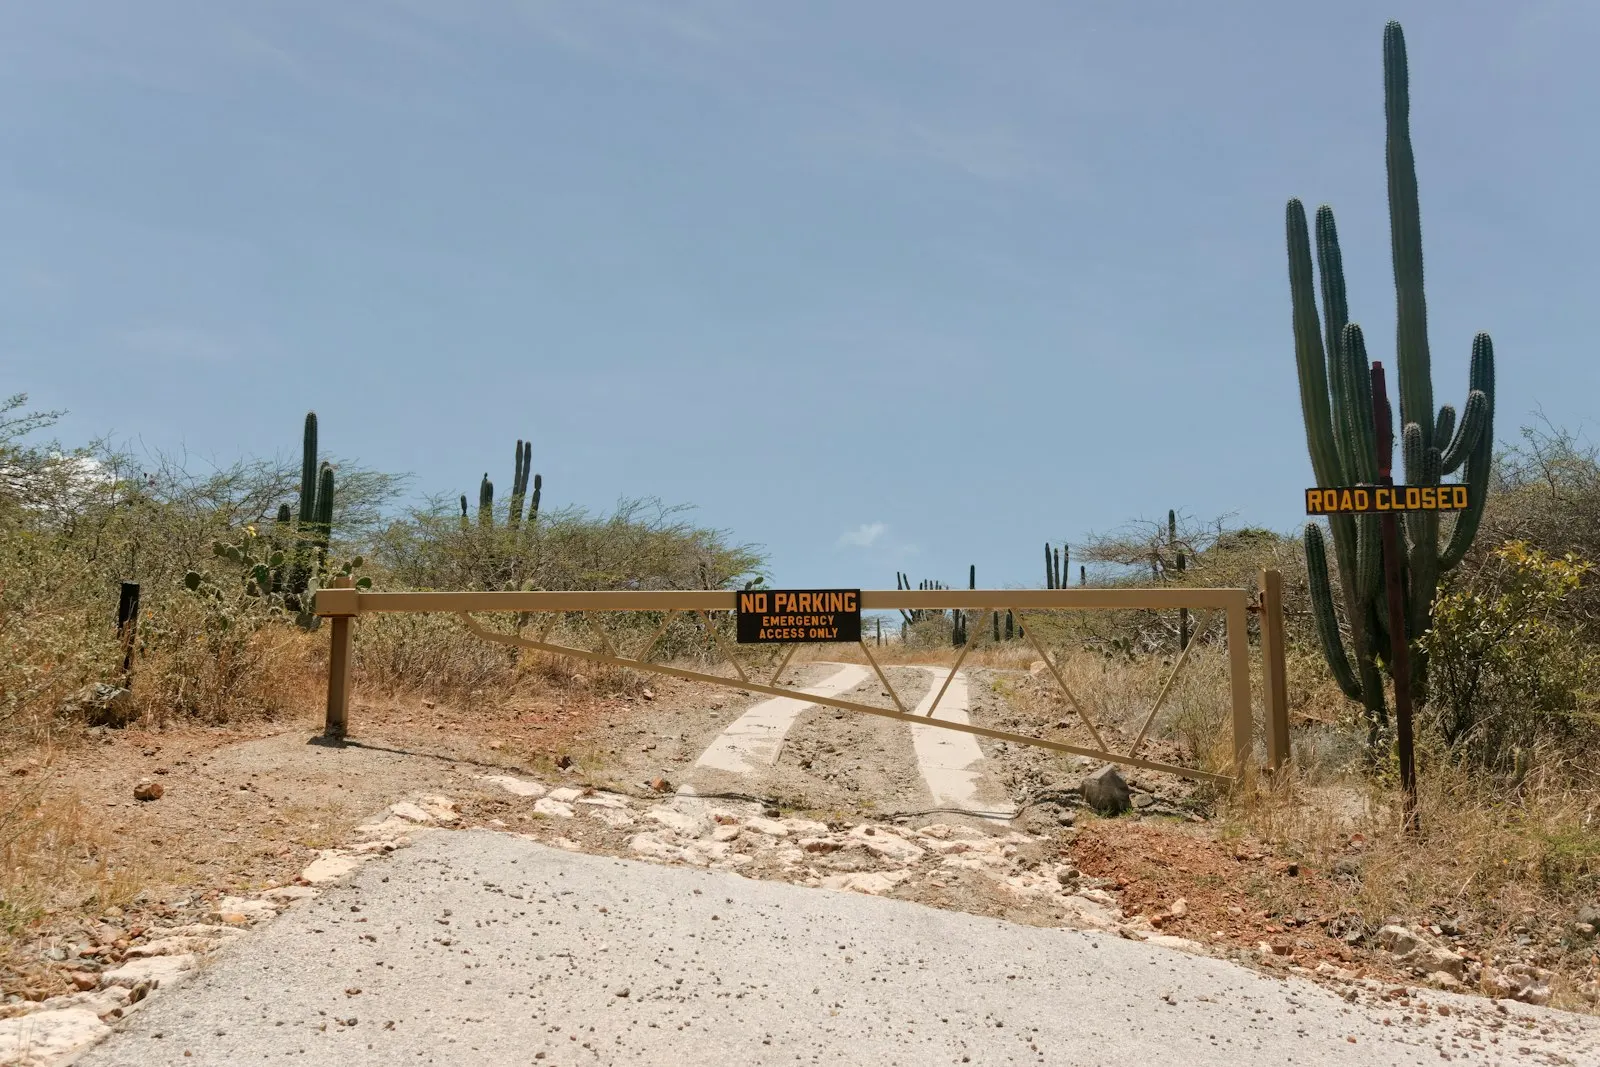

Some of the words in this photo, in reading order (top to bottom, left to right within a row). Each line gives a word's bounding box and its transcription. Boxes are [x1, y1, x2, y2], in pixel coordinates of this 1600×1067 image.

[1307, 489, 1369, 512] ROAD
[1375, 486, 1468, 510] CLOSED
[741, 593, 768, 613] NO
[774, 592, 857, 613] PARKING
[762, 615, 835, 626] EMERGENCY
[759, 628, 805, 639] ACCESS
[809, 627, 839, 638] ONLY
